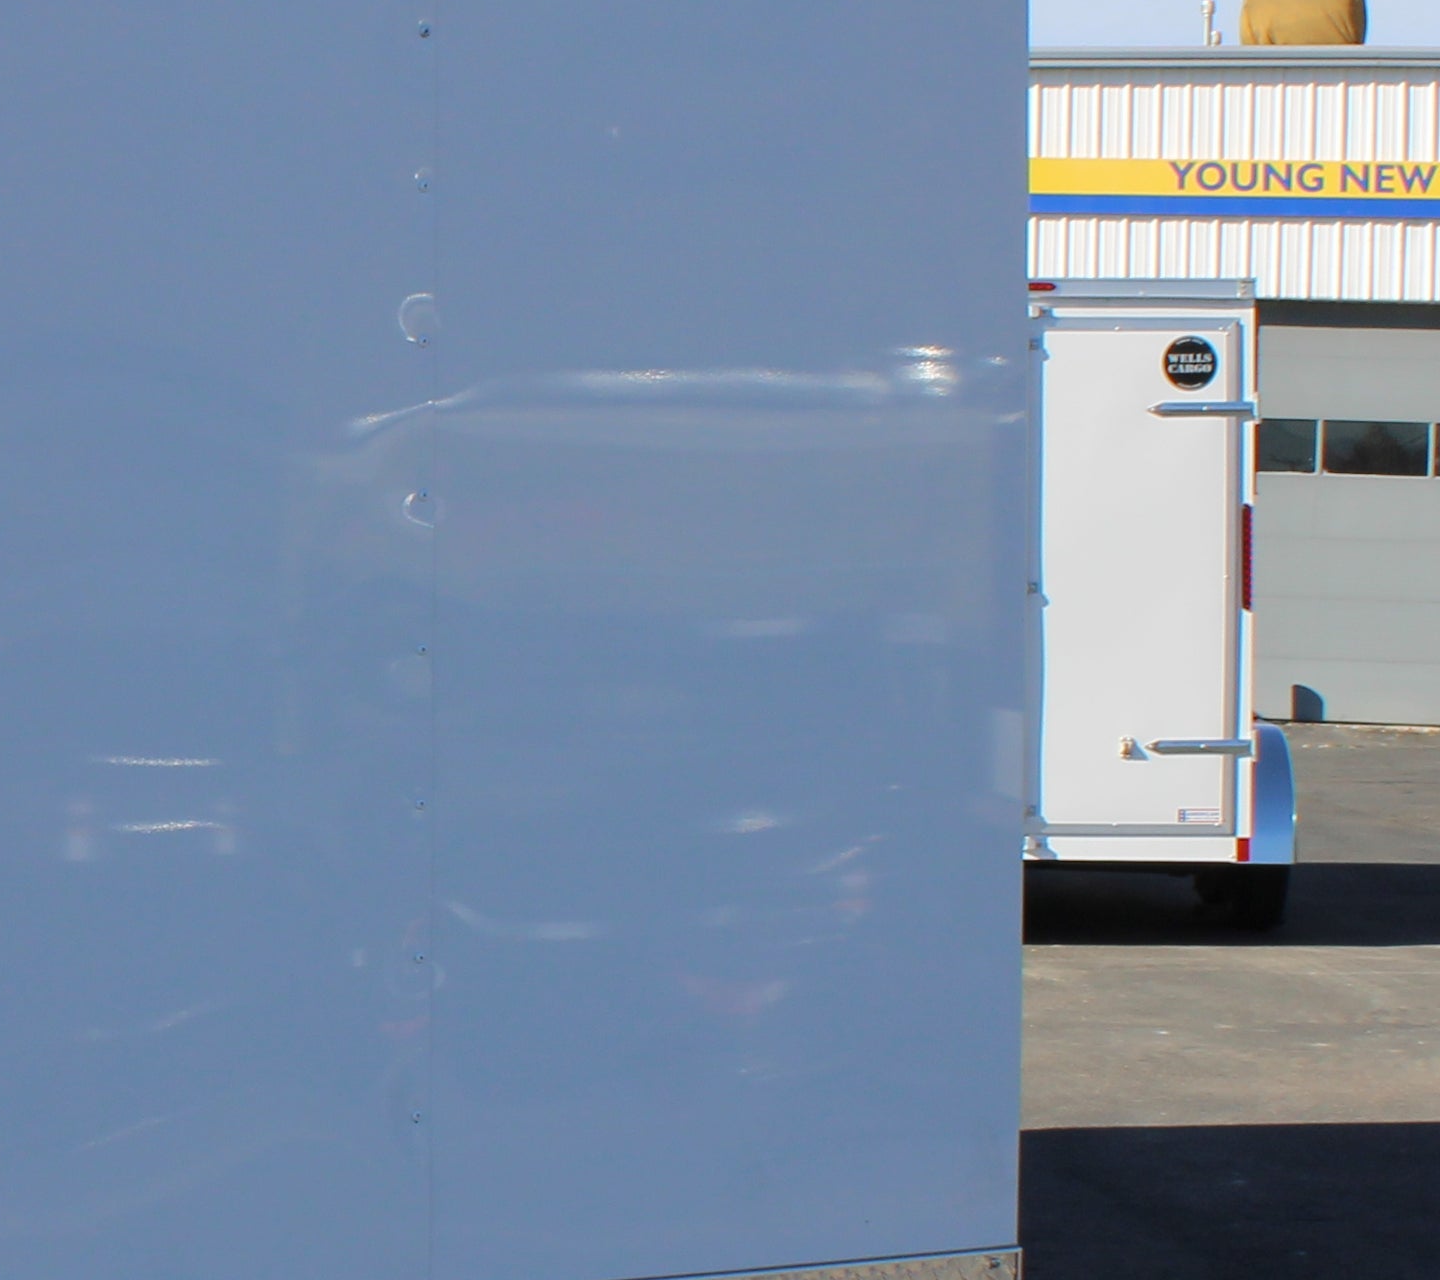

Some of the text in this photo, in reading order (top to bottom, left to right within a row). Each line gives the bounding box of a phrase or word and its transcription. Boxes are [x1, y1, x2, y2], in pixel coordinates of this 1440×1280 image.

[1170, 161, 1325, 193] YOUNG
[1339, 163, 1438, 195] NEW
[1168, 353, 1213, 363] WELLS
[1167, 363, 1213, 373] CARGO
